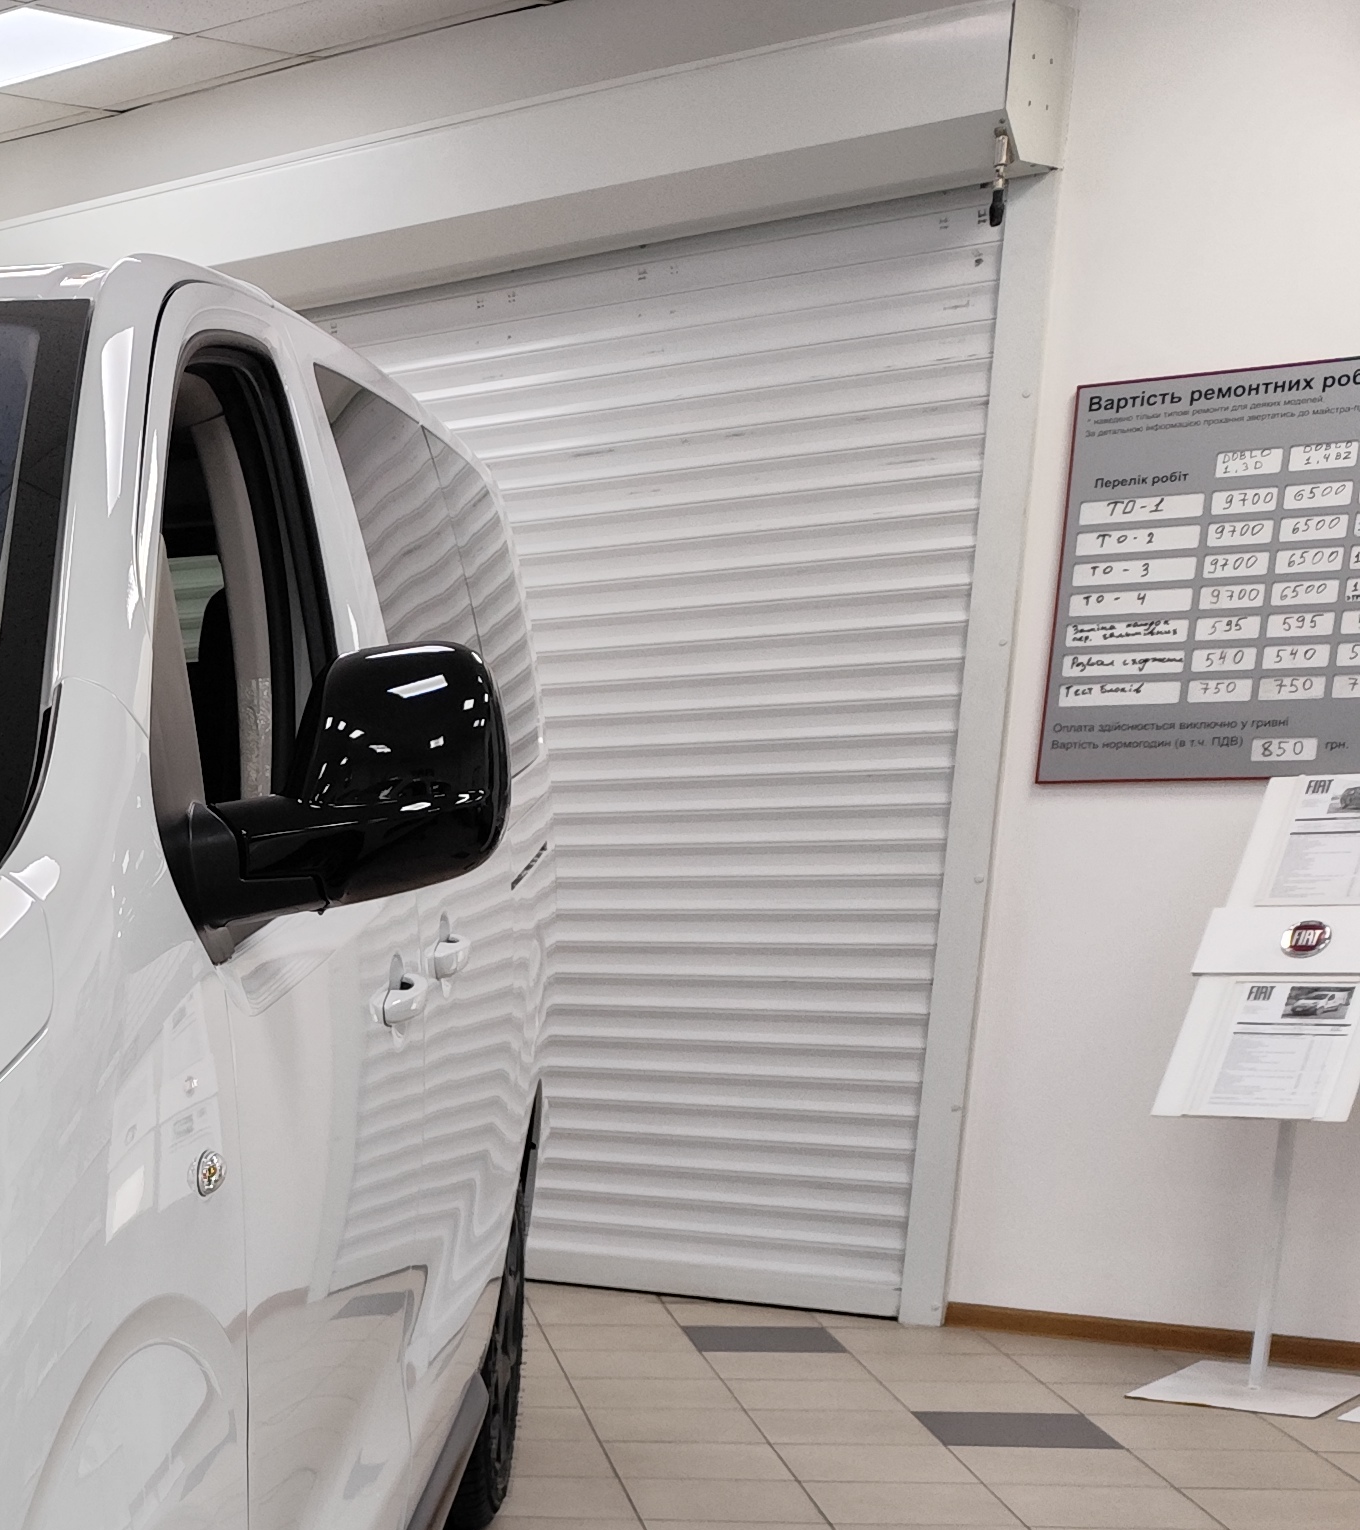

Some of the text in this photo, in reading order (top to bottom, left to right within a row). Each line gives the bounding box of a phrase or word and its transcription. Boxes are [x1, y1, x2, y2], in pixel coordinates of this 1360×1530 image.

[1088, 390, 1182, 413] Вартість
[1189, 376, 1315, 406] ремонтних
[1191, 405, 1230, 417] ремонти
[1231, 402, 1248, 413] для
[1297, 409, 1310, 418] до
[1094, 471, 1189, 489] Перелік робіт
[1223, 492, 1274, 510] 9700
[1294, 484, 1347, 501] 6500
[1215, 523, 1264, 539] 9700
[1292, 517, 1340, 535] 6500
[1207, 555, 1258, 574] 9700
[1287, 550, 1339, 568] 6500
[1210, 588, 1260, 604] 9700
[1280, 583, 1327, 601] 6500
[1208, 616, 1249, 635] 595
[1282, 613, 1324, 631] 595
[1205, 650, 1245, 668] 540
[1274, 648, 1316, 664] 540
[1200, 681, 1237, 694] 750
[1274, 678, 1313, 694] 750
[1053, 718, 1289, 733] Оплата здійснюється виключно у гривні
[1050, 739, 1099, 751] Вартість
[1101, 739, 1171, 750] нормогодин
[1211, 736, 1244, 747] ПДВ)
[1261, 740, 1304, 757] 850
[1325, 741, 1349, 751] грн.
[1305, 779, 1334, 795] FIAT
[1291, 929, 1324, 946] FIAT
[1247, 985, 1277, 1001] FIAT
